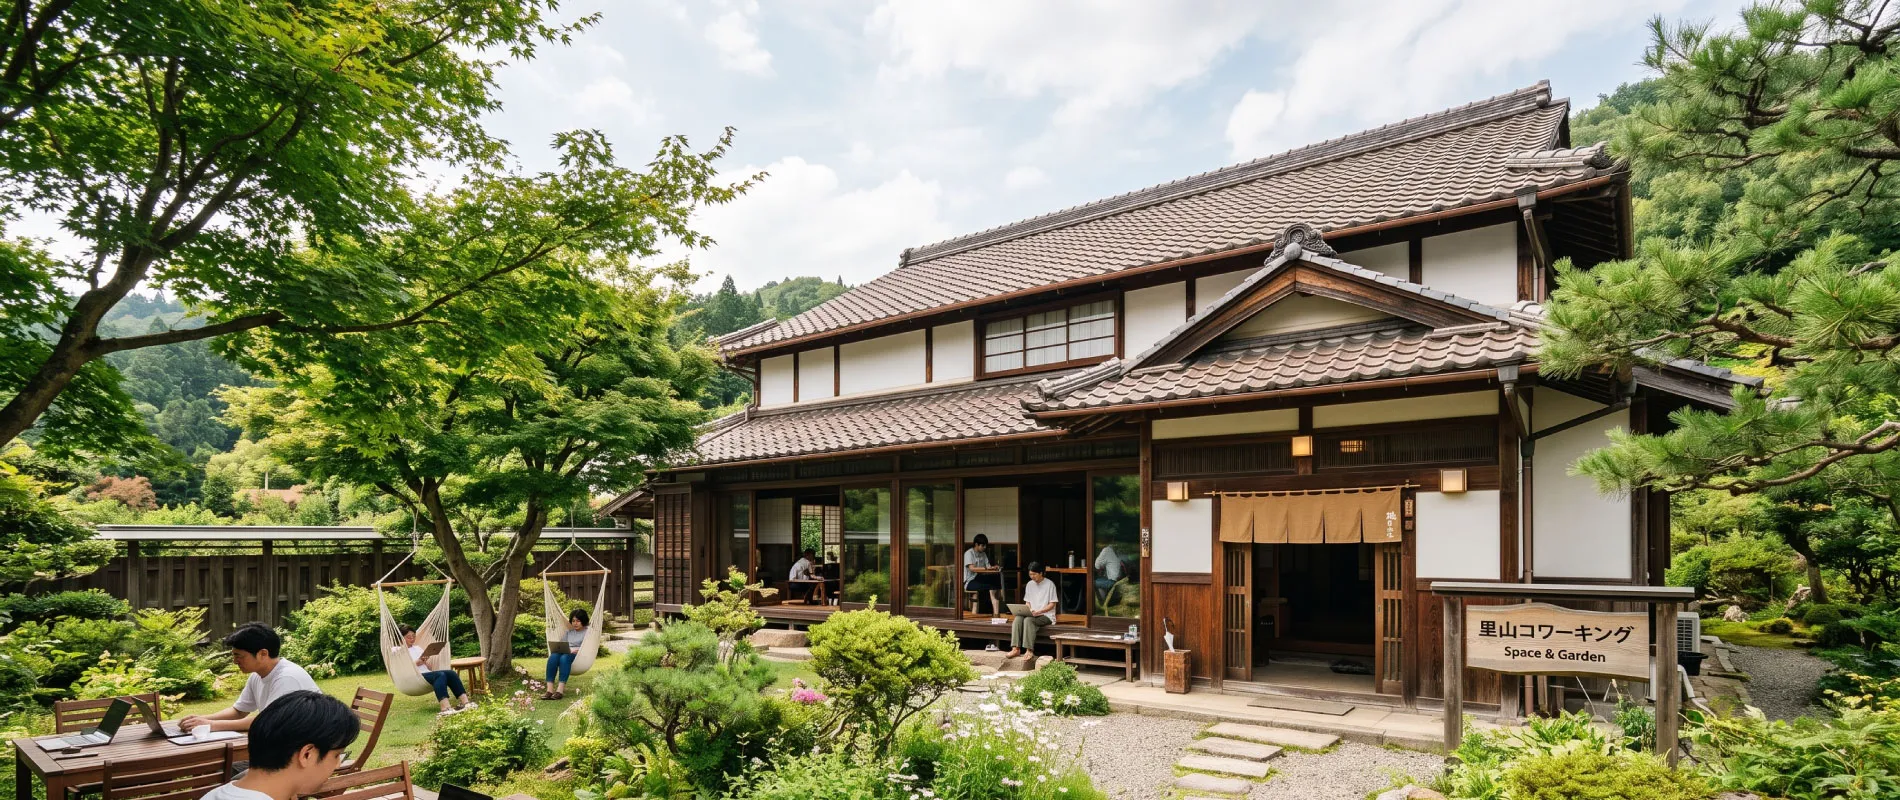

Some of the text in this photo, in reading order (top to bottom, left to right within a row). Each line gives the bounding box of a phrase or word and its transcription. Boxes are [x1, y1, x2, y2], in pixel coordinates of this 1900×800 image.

[1478, 620, 1635, 643] 里山コワーキング
[1504, 646, 1606, 662] Space & Garden
